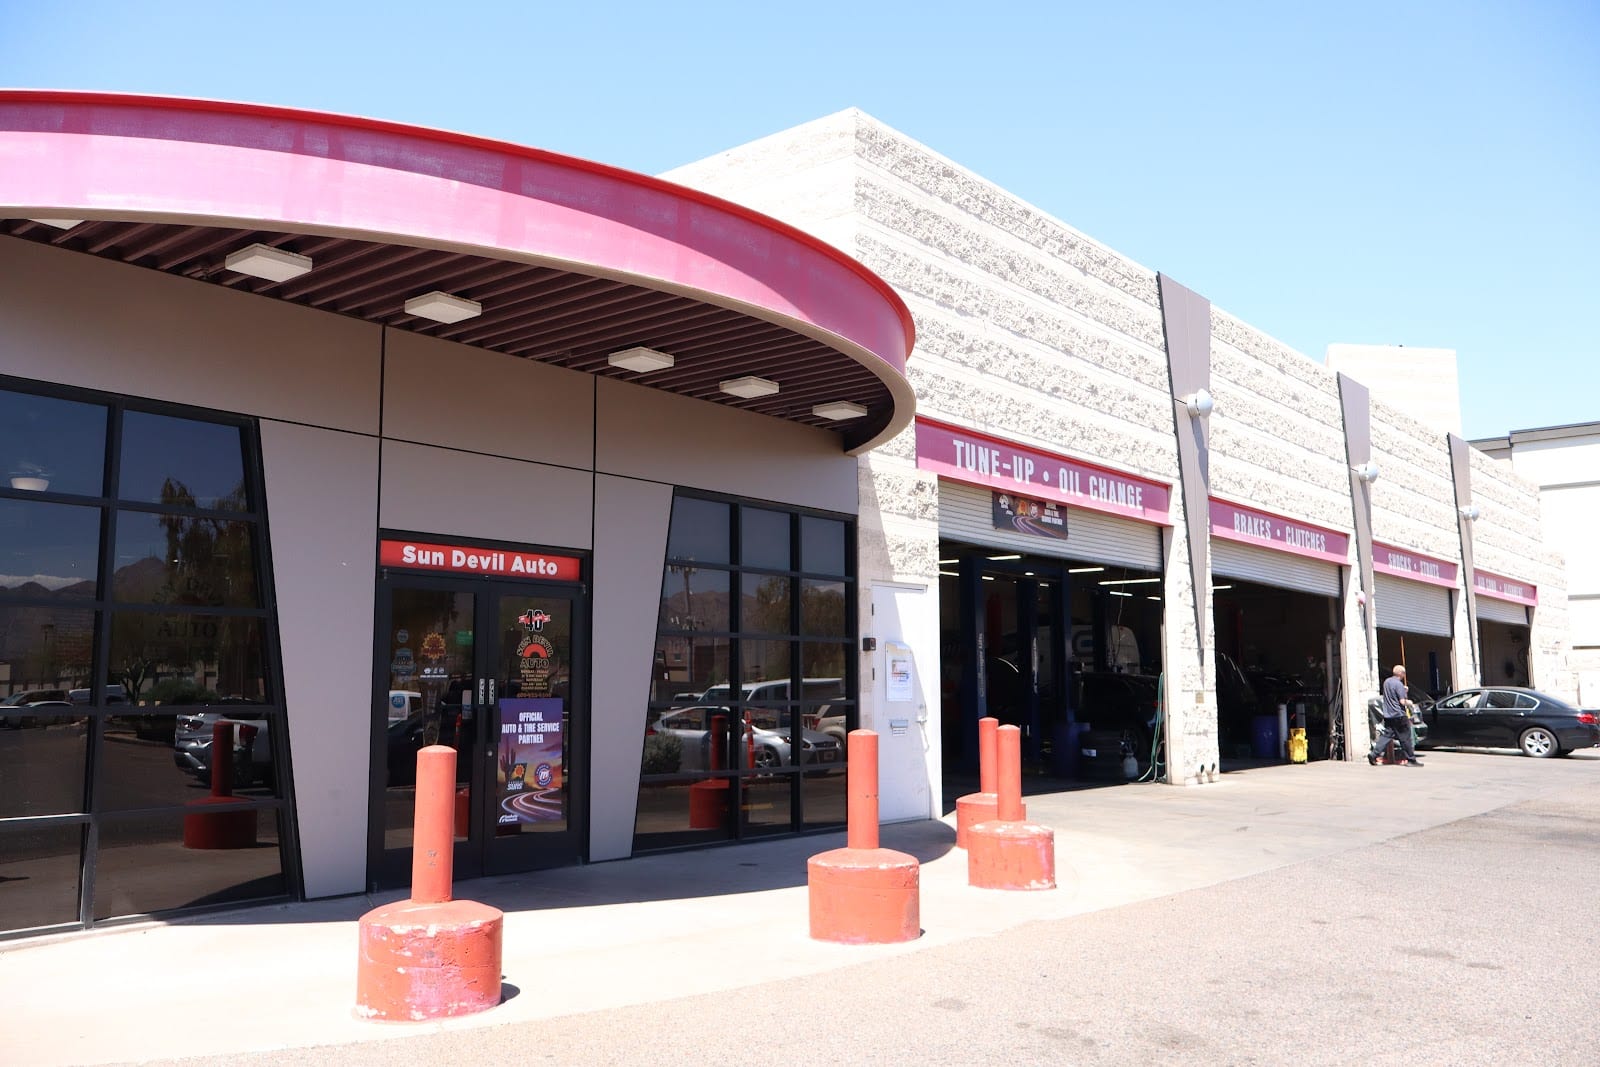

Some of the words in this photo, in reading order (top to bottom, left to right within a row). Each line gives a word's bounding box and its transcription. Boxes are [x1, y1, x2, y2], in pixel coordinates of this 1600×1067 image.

[953, 440, 1034, 485] TUNE-UP
[1059, 468, 1083, 497] OIL
[1089, 476, 1144, 510] CHANGE
[1233, 512, 1271, 541] BRAKES
[1285, 526, 1326, 553] CLUTCHES
[402, 546, 444, 566] Sun
[452, 550, 504, 571] Devil
[511, 556, 558, 576] Auto
[1388, 553, 1412, 573] SHOCKS
[520, 658, 549, 669] AUTO
[519, 712, 543, 722] OFFICIAL
[501, 723, 516, 734] AUTO
[524, 723, 537, 733] TIRE
[537, 722, 560, 732] SERVICE
[518, 734, 543, 744] PARTNER
